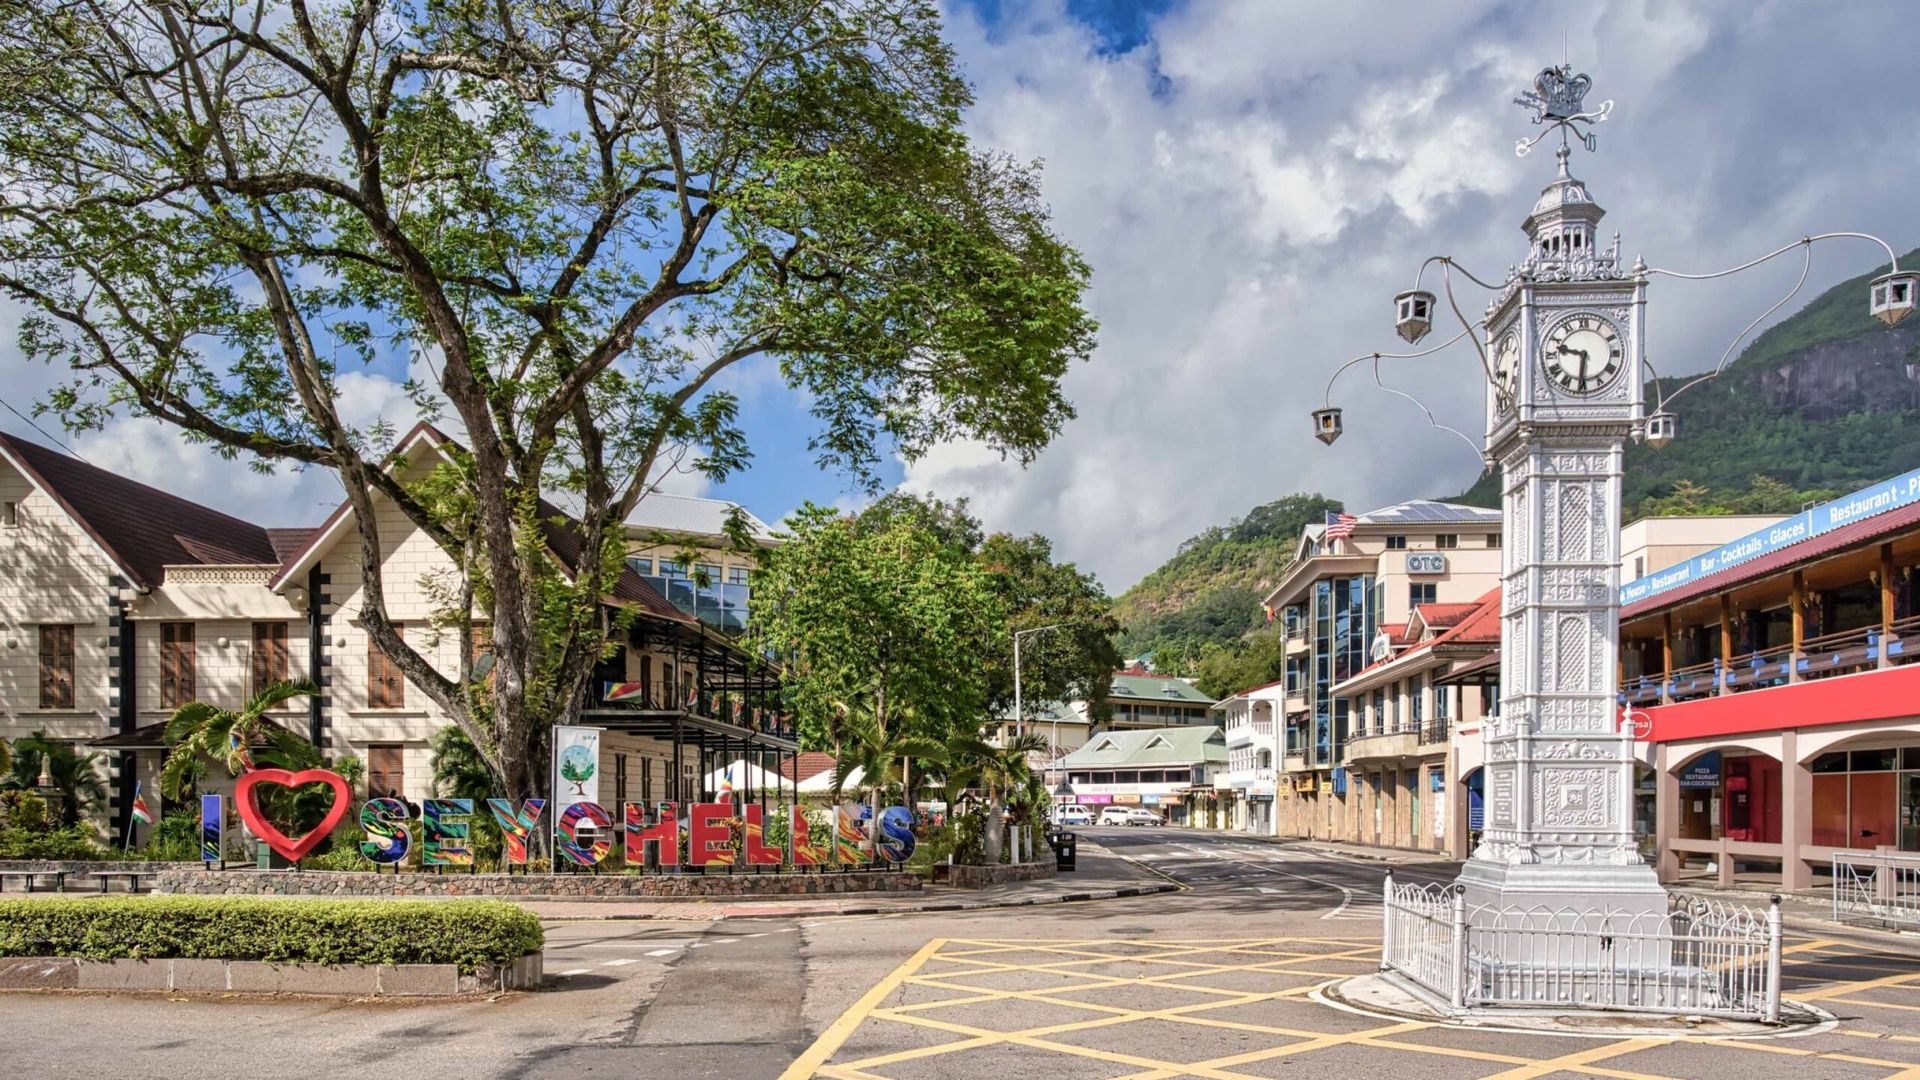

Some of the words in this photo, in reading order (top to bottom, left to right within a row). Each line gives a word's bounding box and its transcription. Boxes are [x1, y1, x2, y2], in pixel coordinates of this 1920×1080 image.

[1829, 486, 1898, 523] Restaurant
[1700, 557, 1715, 572] Bar
[1720, 539, 1762, 564] Cocktails
[1770, 522, 1805, 546] Glaces
[1409, 556, 1442, 571] OTC
[1651, 566, 1691, 591] Restaurant
[1632, 719, 1649, 728] bsa
[202, 795, 222, 861] I
[360, 797, 917, 865] SEYCHELLES
